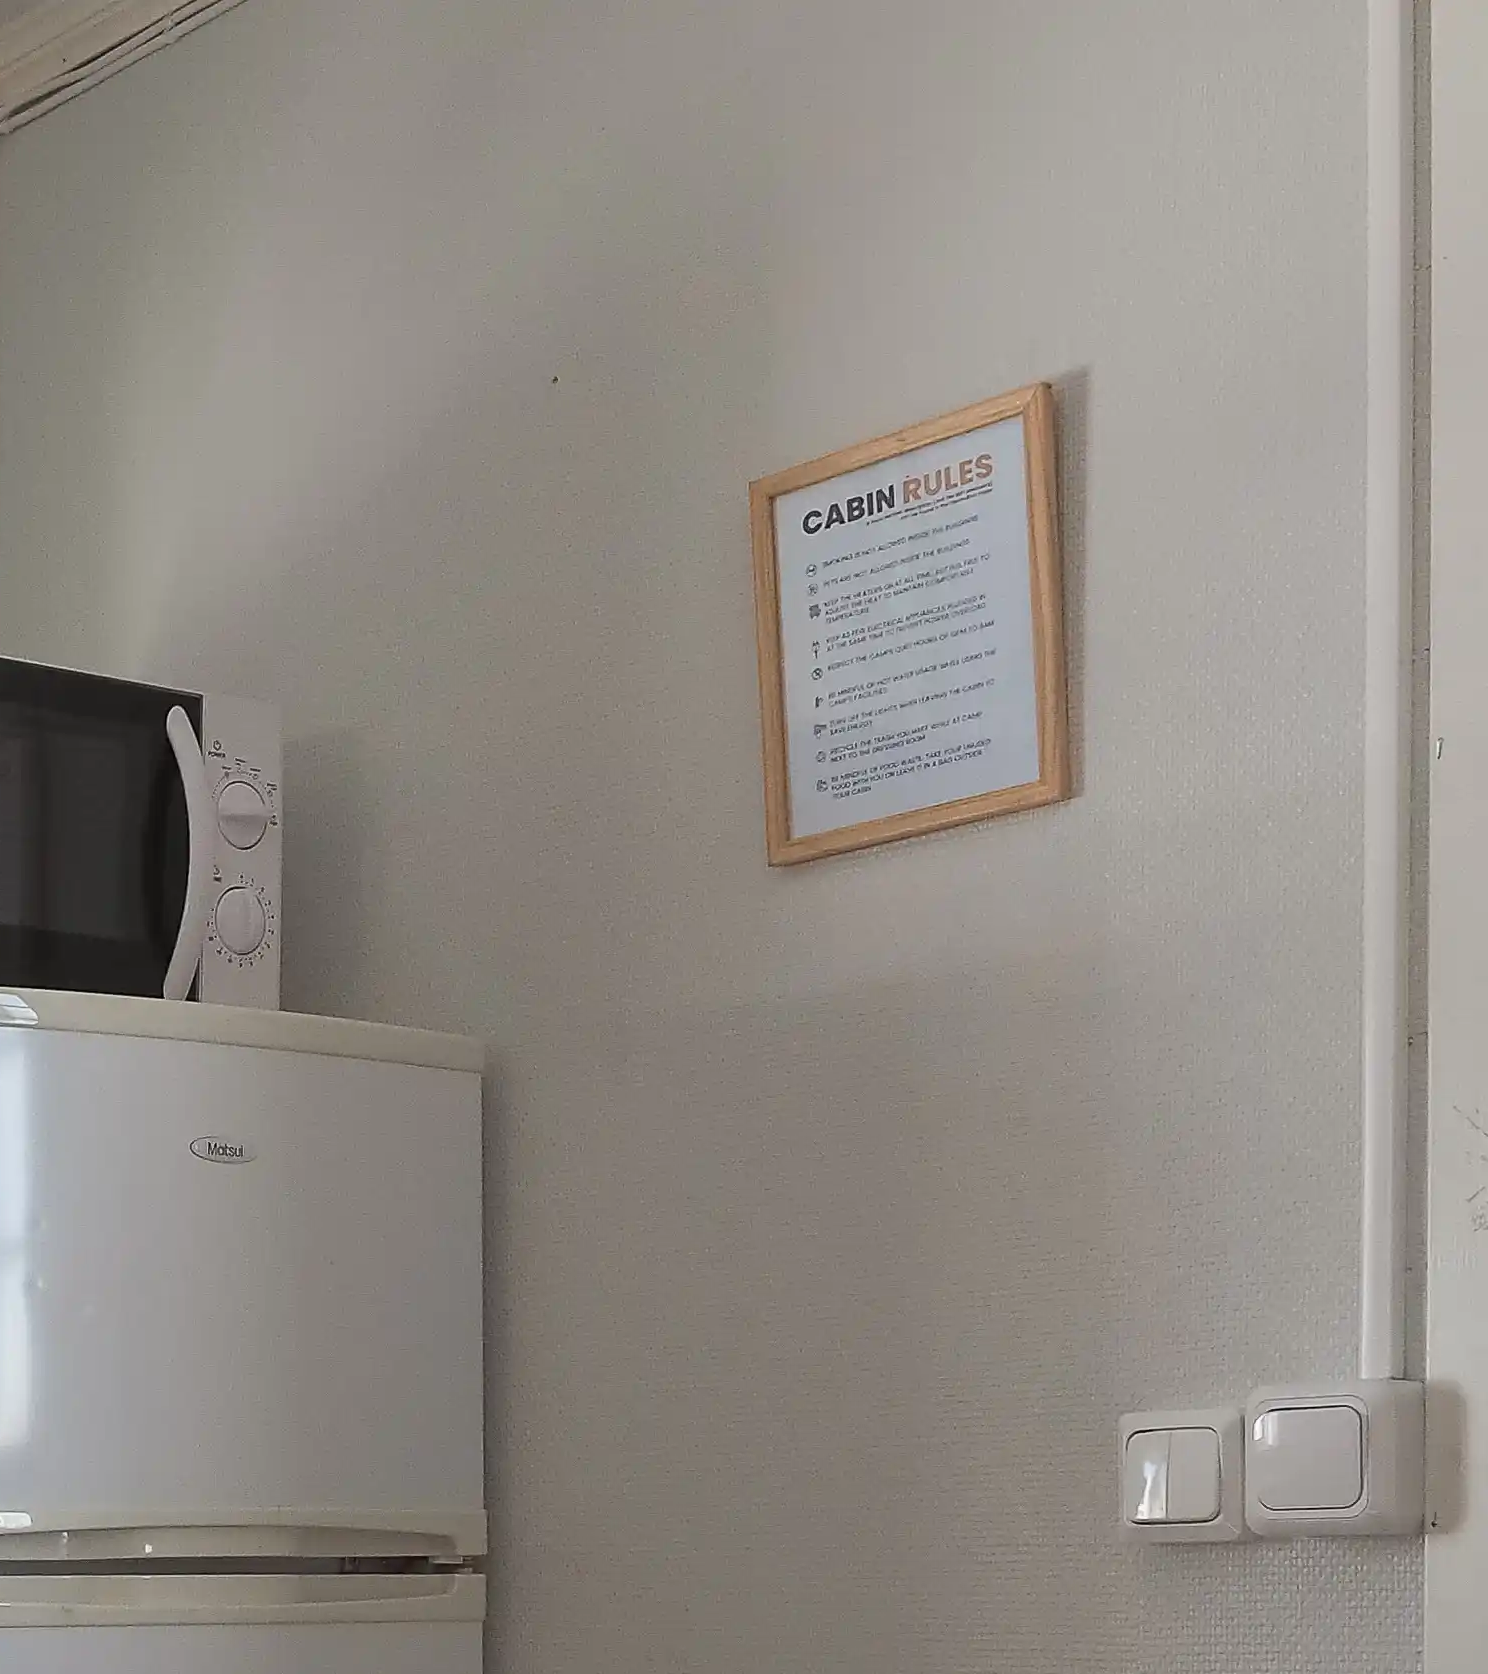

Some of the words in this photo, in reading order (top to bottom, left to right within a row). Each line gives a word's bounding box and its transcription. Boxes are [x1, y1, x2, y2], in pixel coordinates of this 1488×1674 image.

[802, 484, 895, 535] CABIN
[902, 453, 993, 505] RULES
[207, 1141, 245, 1158] Matsui
